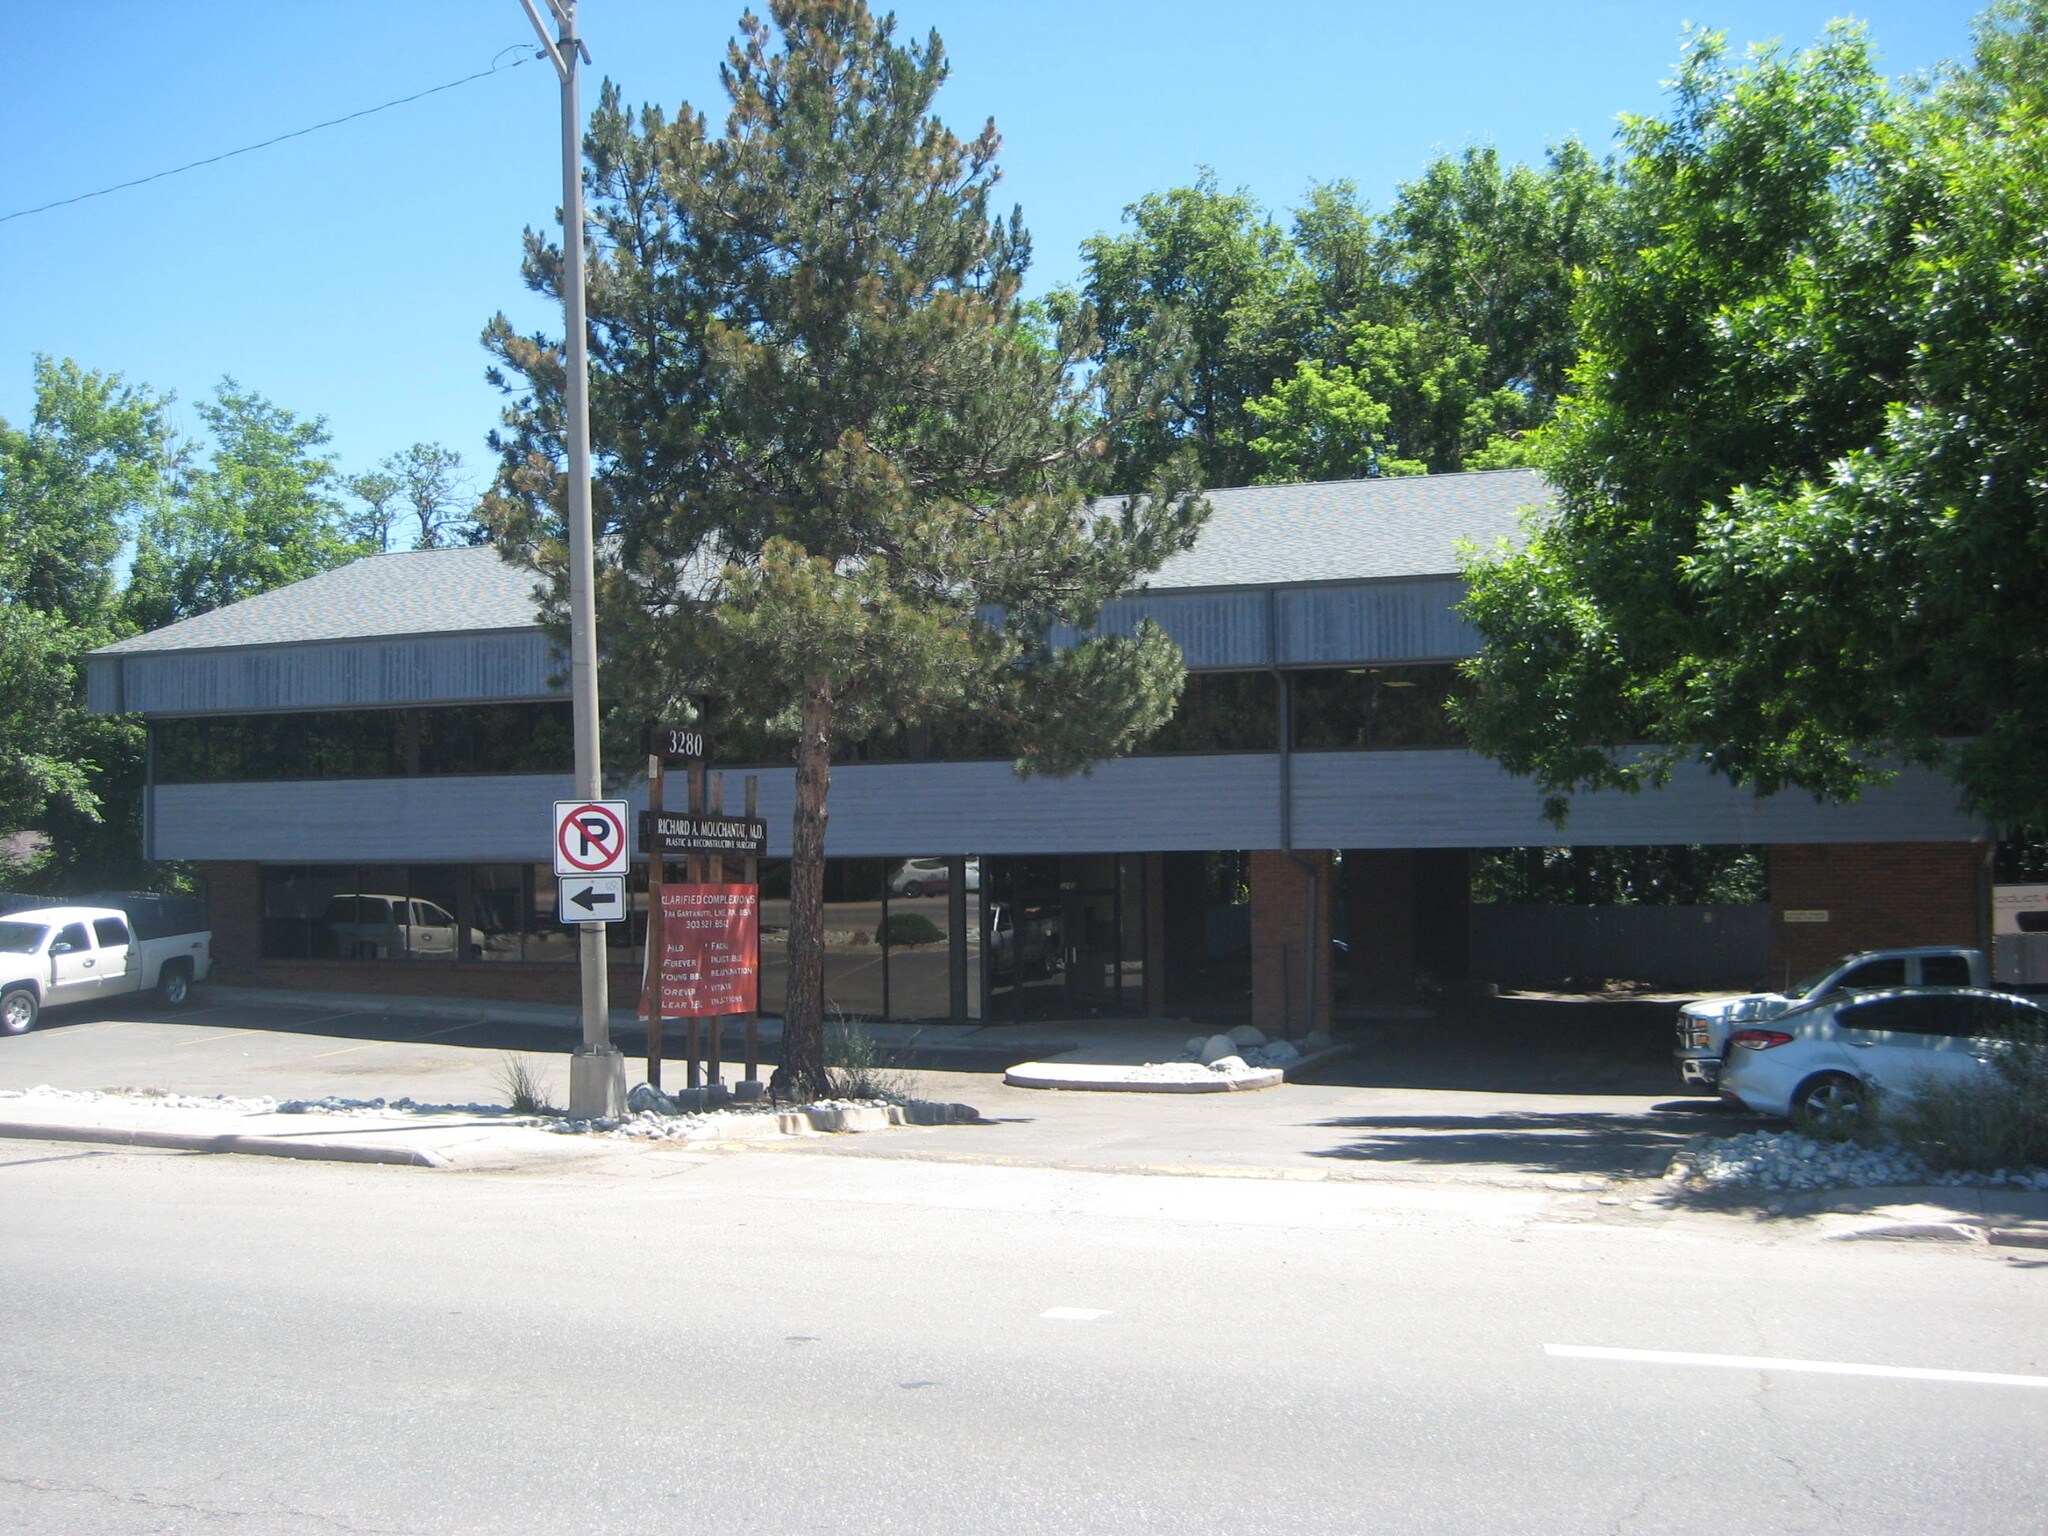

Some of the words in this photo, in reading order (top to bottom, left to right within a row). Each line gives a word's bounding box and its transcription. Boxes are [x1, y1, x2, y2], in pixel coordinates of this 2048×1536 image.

[669, 730, 703, 757] 3280
[657, 818, 690, 835] RICHARD
[665, 838, 686, 847] PLASTIC
[736, 841, 757, 850] SURGERY
[661, 895, 702, 905] CLARIFIED
[703, 894, 756, 905] COMPLEXIONS
[1996, 893, 2041, 904] oduct
[663, 959, 696, 968] FOREVER
[660, 972, 688, 981] YOUNG
[661, 1001, 687, 1009] LEAR
